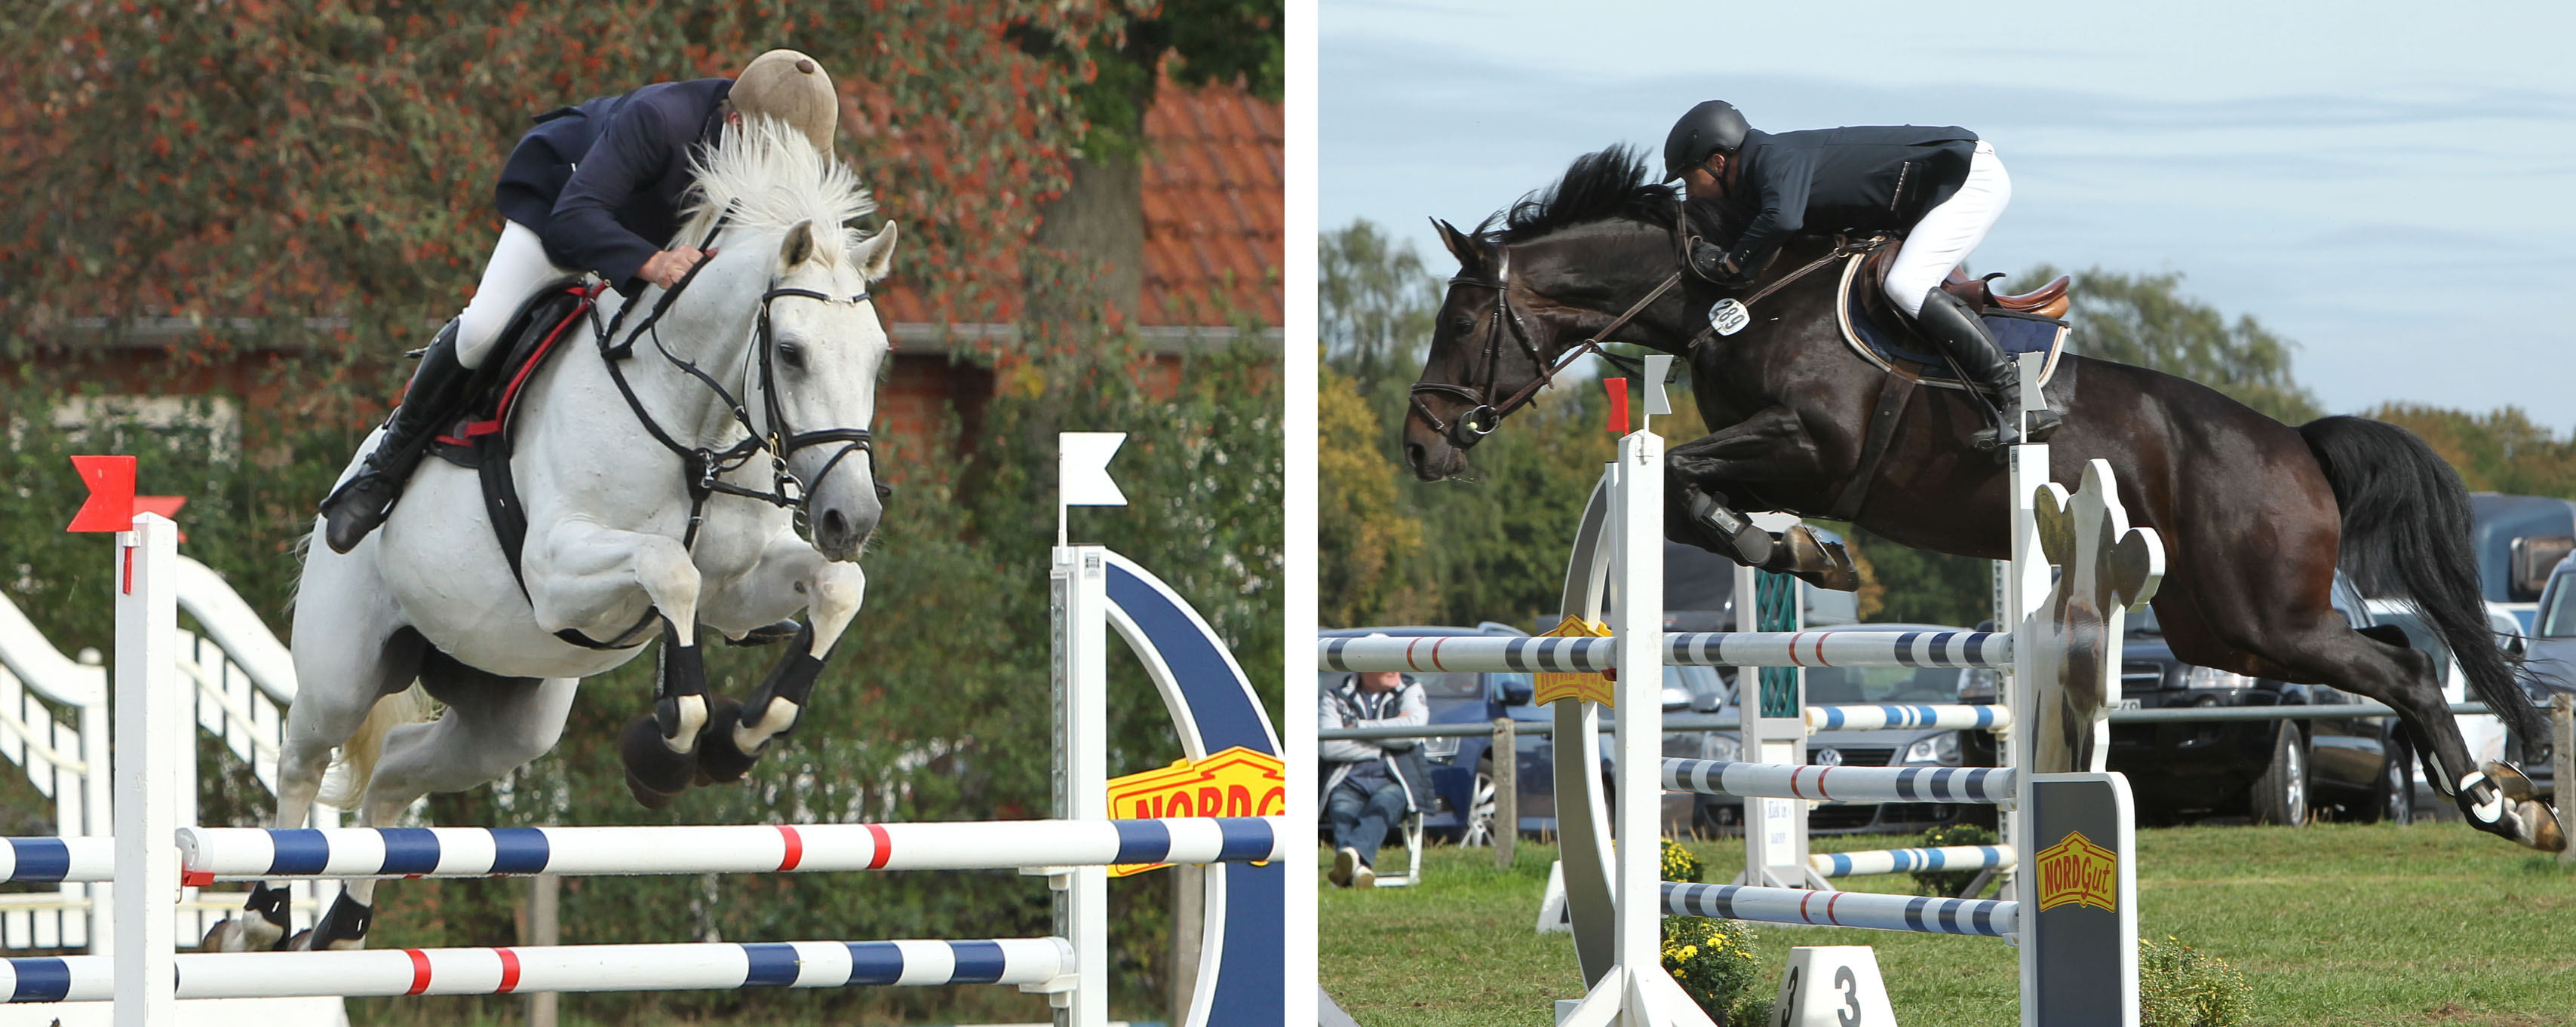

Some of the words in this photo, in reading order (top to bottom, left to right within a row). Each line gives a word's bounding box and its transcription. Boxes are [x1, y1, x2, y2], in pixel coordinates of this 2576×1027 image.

[1712, 300, 1745, 330] 289
[2044, 854, 2111, 900] NORDGut
[1781, 965, 1798, 1027] 3
[1835, 965, 1861, 1027] 3
